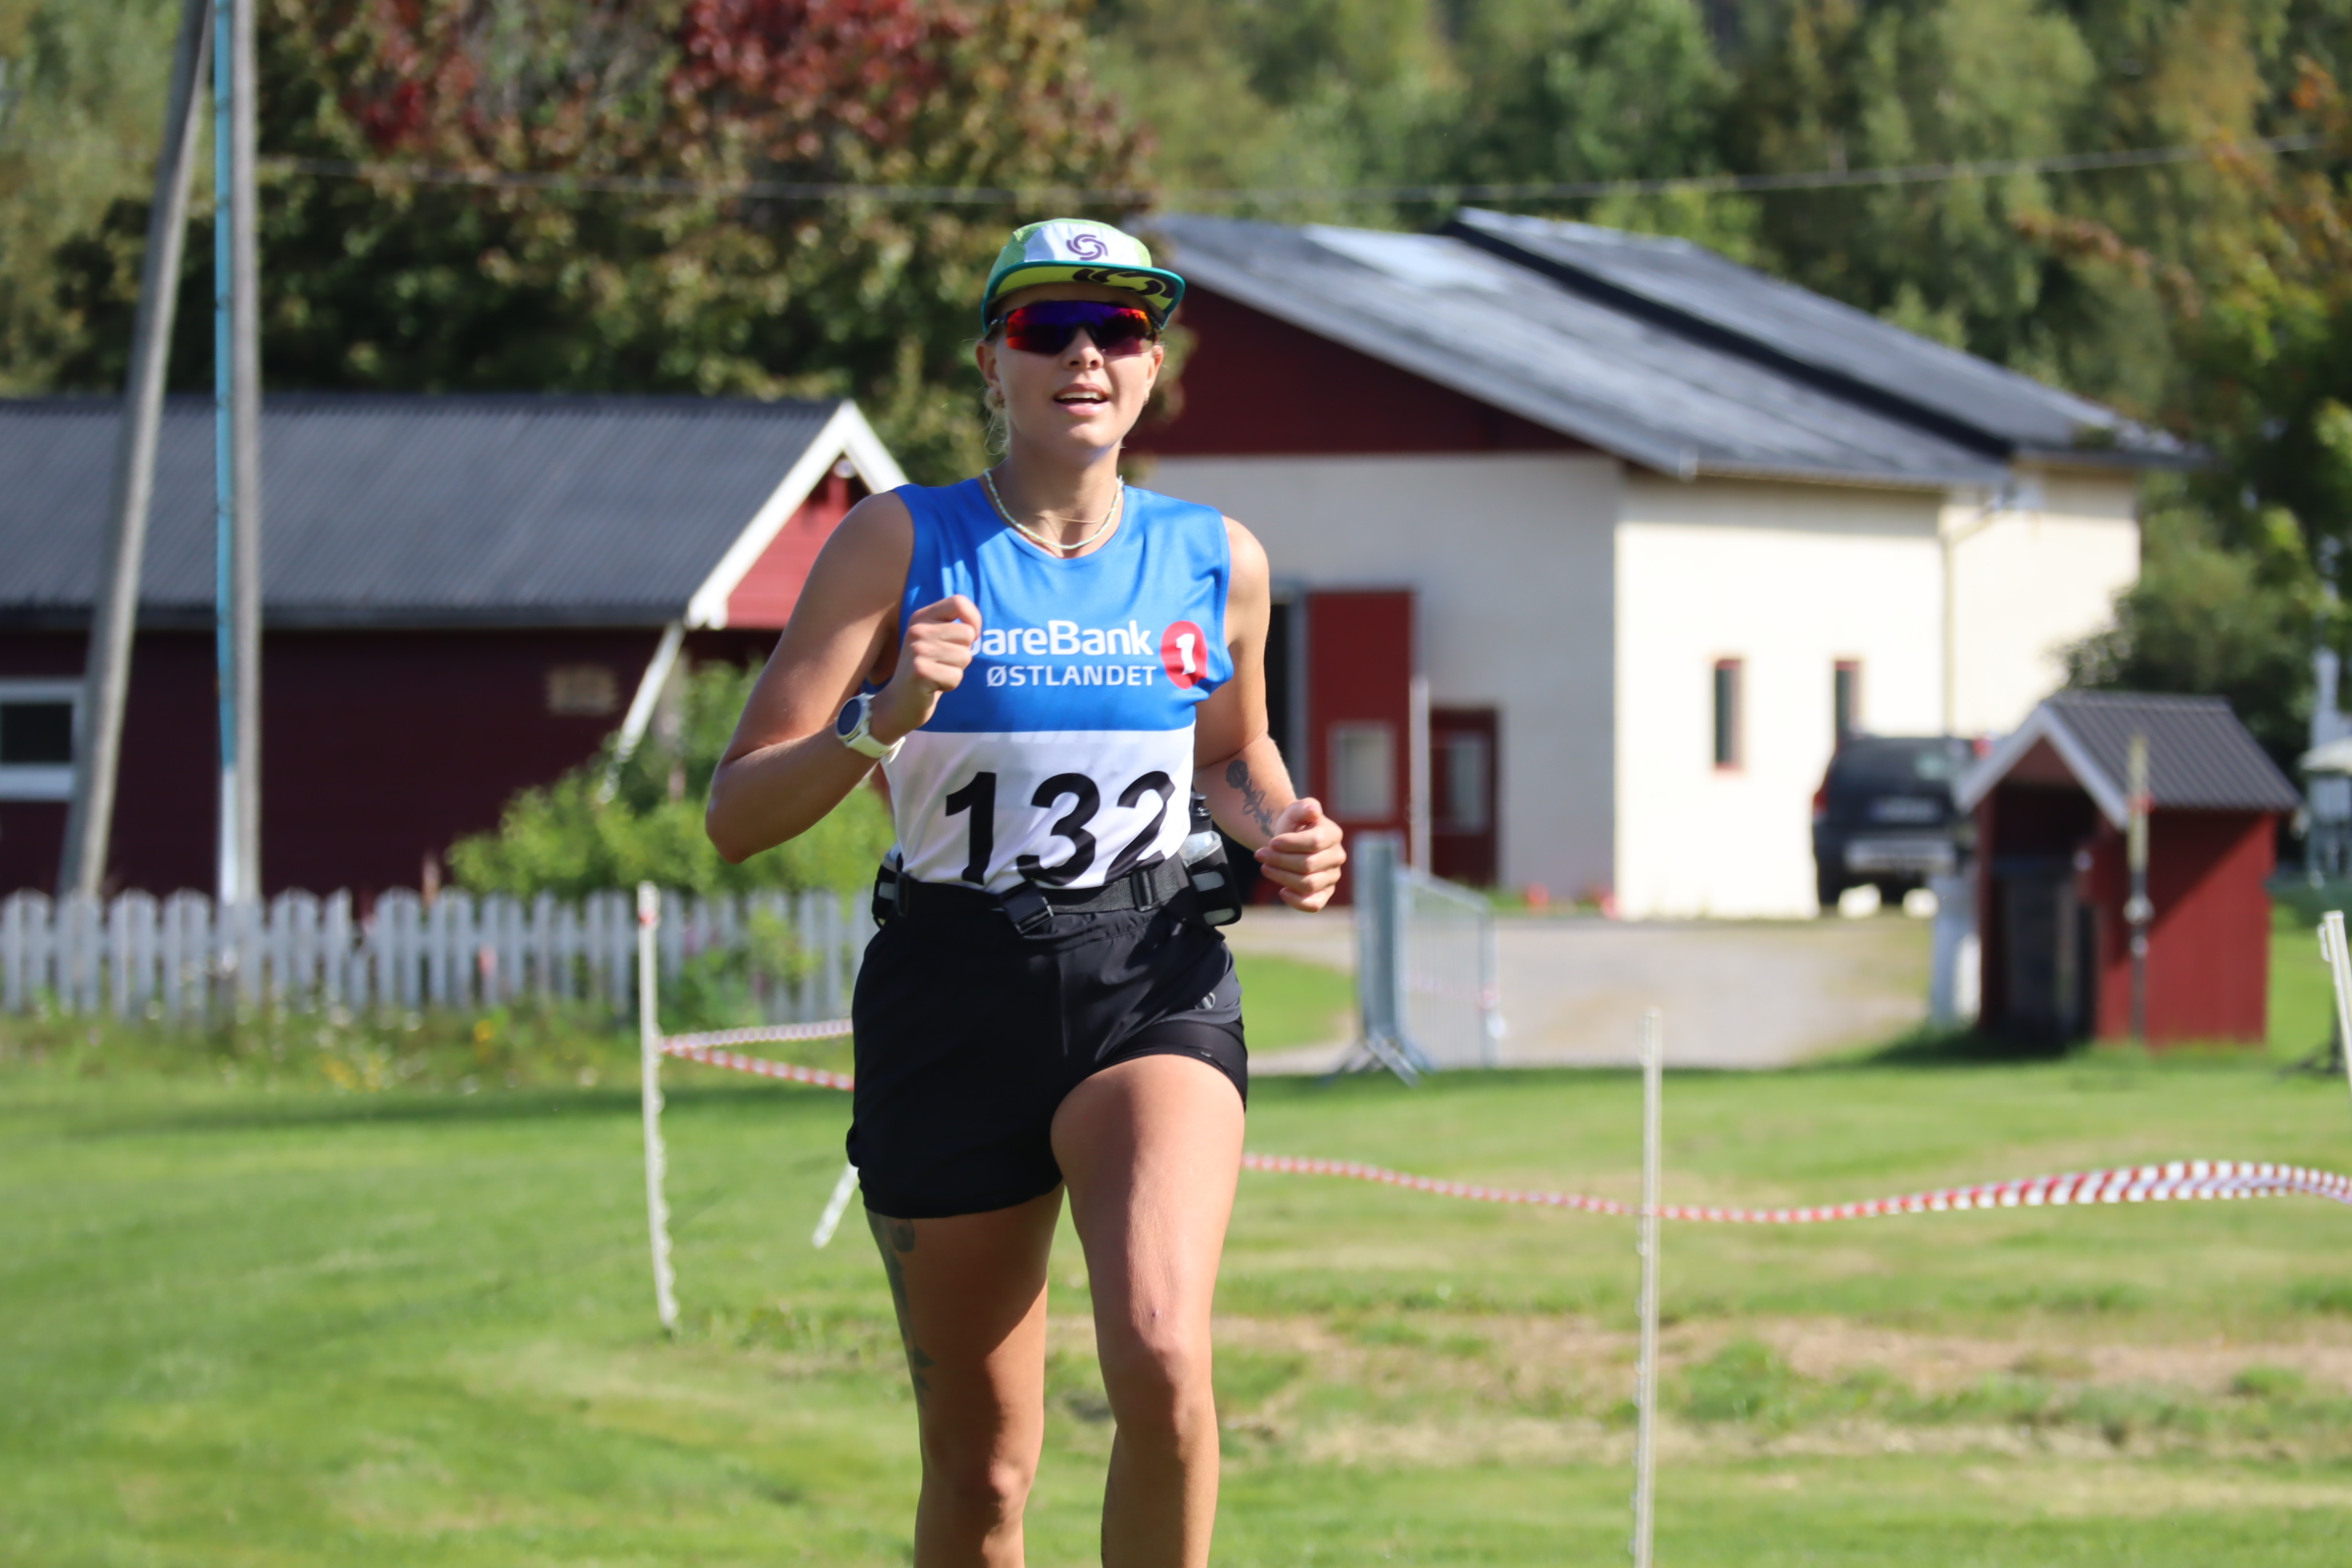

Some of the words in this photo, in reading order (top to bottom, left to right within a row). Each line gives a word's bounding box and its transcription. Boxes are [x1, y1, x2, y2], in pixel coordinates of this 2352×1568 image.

[970, 619, 1154, 657] areBank
[1175, 633, 1197, 676] 1
[986, 664, 1158, 688] ØSTLANDET
[945, 770, 1176, 886] 132
